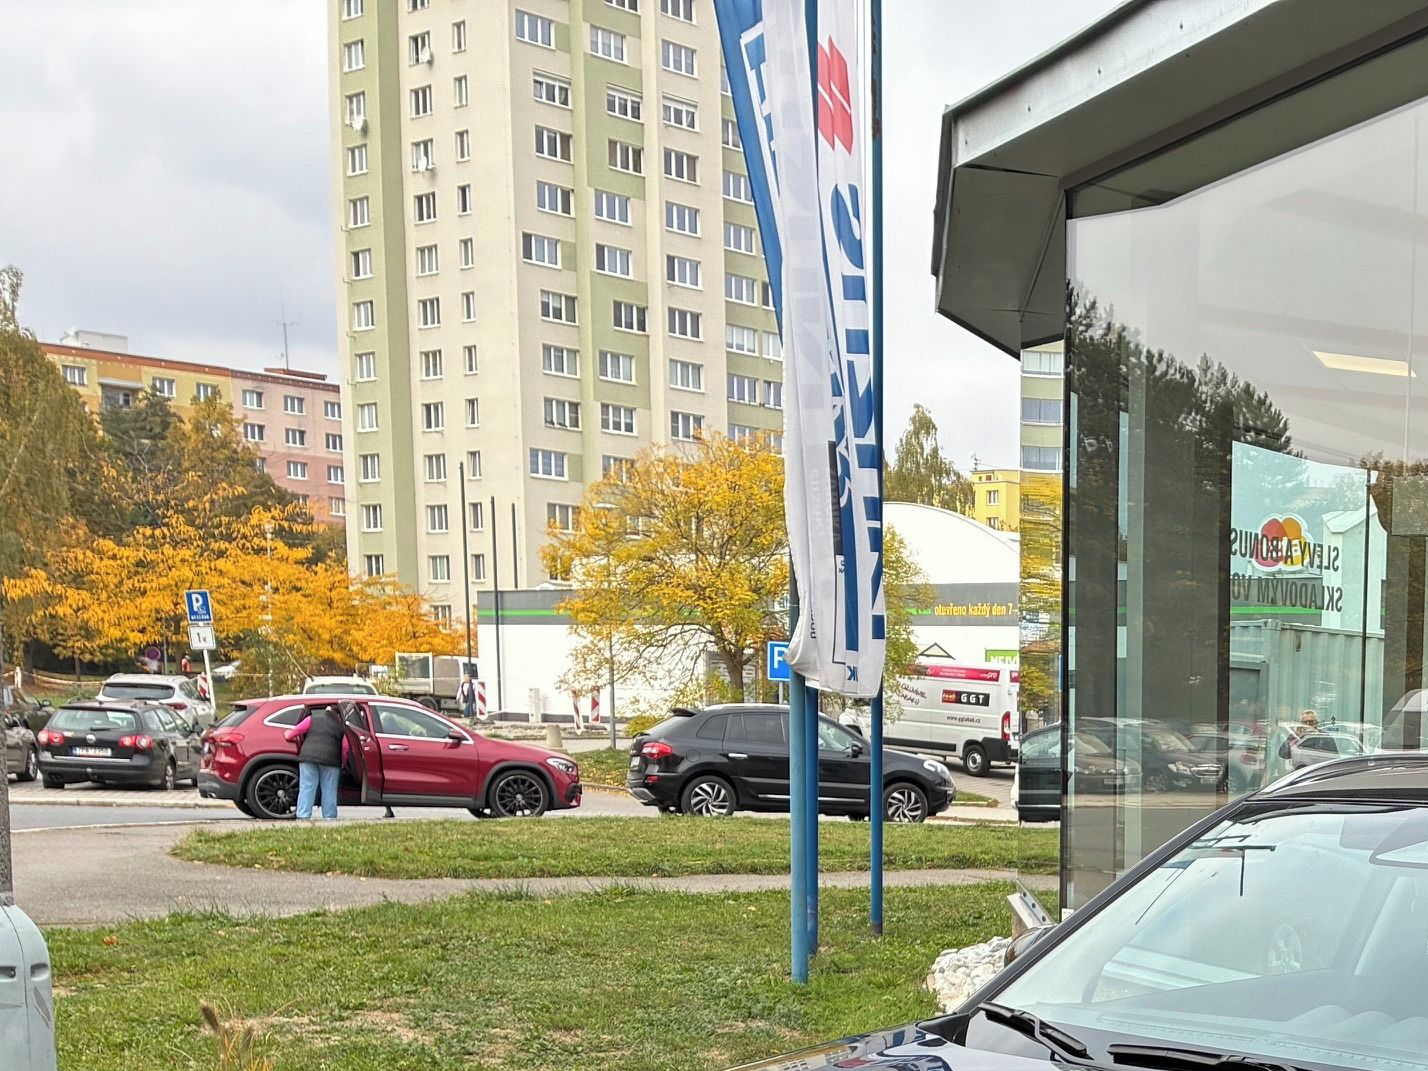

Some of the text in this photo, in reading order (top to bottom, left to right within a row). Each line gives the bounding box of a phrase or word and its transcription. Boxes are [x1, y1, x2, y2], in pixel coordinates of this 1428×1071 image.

[191, 593, 203, 612] P
[934, 603, 967, 616] otevřeno
[968, 603, 991, 617] každý
[992, 604, 1006, 615] den
[773, 646, 788, 669] P
[960, 693, 984, 705] GGT
